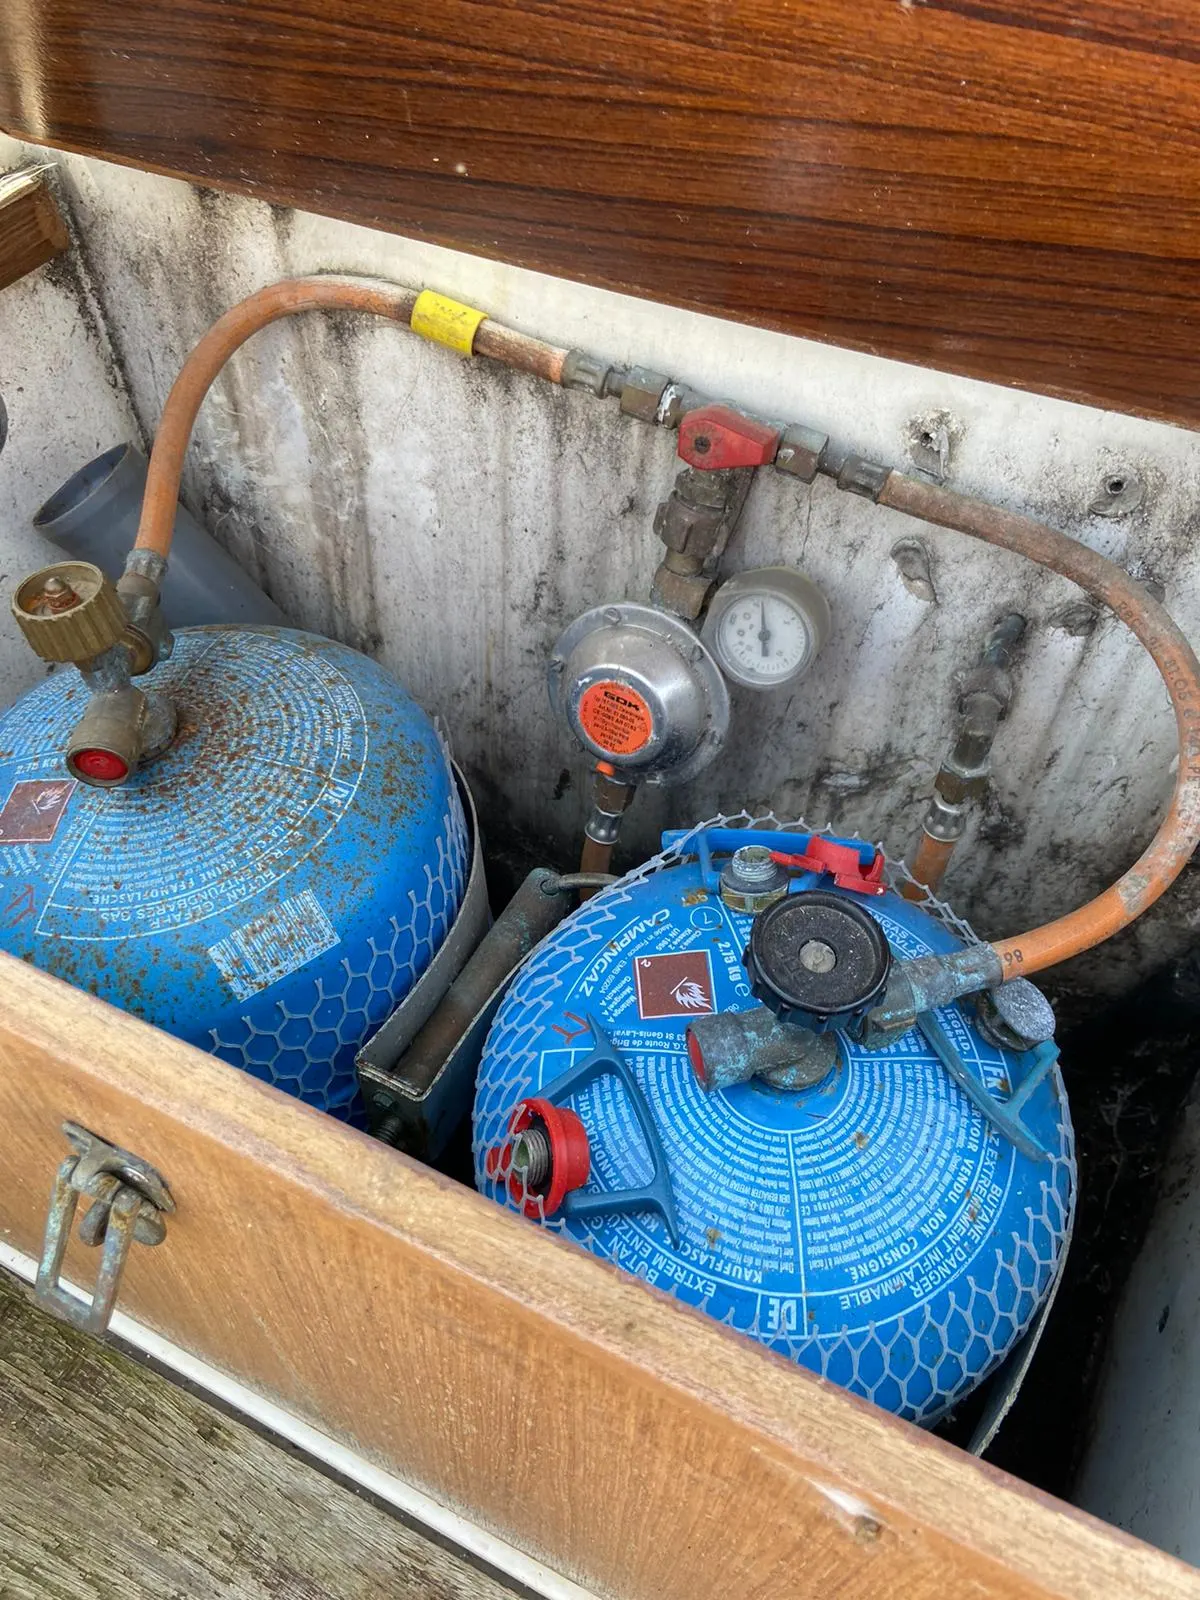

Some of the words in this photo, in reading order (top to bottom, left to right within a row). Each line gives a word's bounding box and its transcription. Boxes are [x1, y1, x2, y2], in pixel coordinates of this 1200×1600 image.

[603, 690, 641, 712] GOK
[578, 908, 670, 997] CAMPINGAZ
[669, 927, 681, 939] UN
[640, 957, 652, 968] 2
[609, 1037, 630, 1047] Brig
[630, 1038, 643, 1048] de
[644, 1039, 670, 1049] Route
[665, 1031, 675, 1039] St
[965, 1102, 981, 1154] RVOIR
[937, 1144, 998, 1255] EXTREMEMENT
[942, 1154, 975, 1210] VENDU.
[917, 1204, 948, 1240] NON
[964, 1180, 1003, 1245] BUTANE
[606, 1233, 661, 1286] BUTAN
[649, 1250, 718, 1299] EXTREM
[837, 1242, 945, 1312] INFLAMMABLE
[843, 1231, 921, 1284] CONSIGNÉ.
[907, 1242, 968, 1300] DANGER
[766, 1296, 799, 1330] DE
